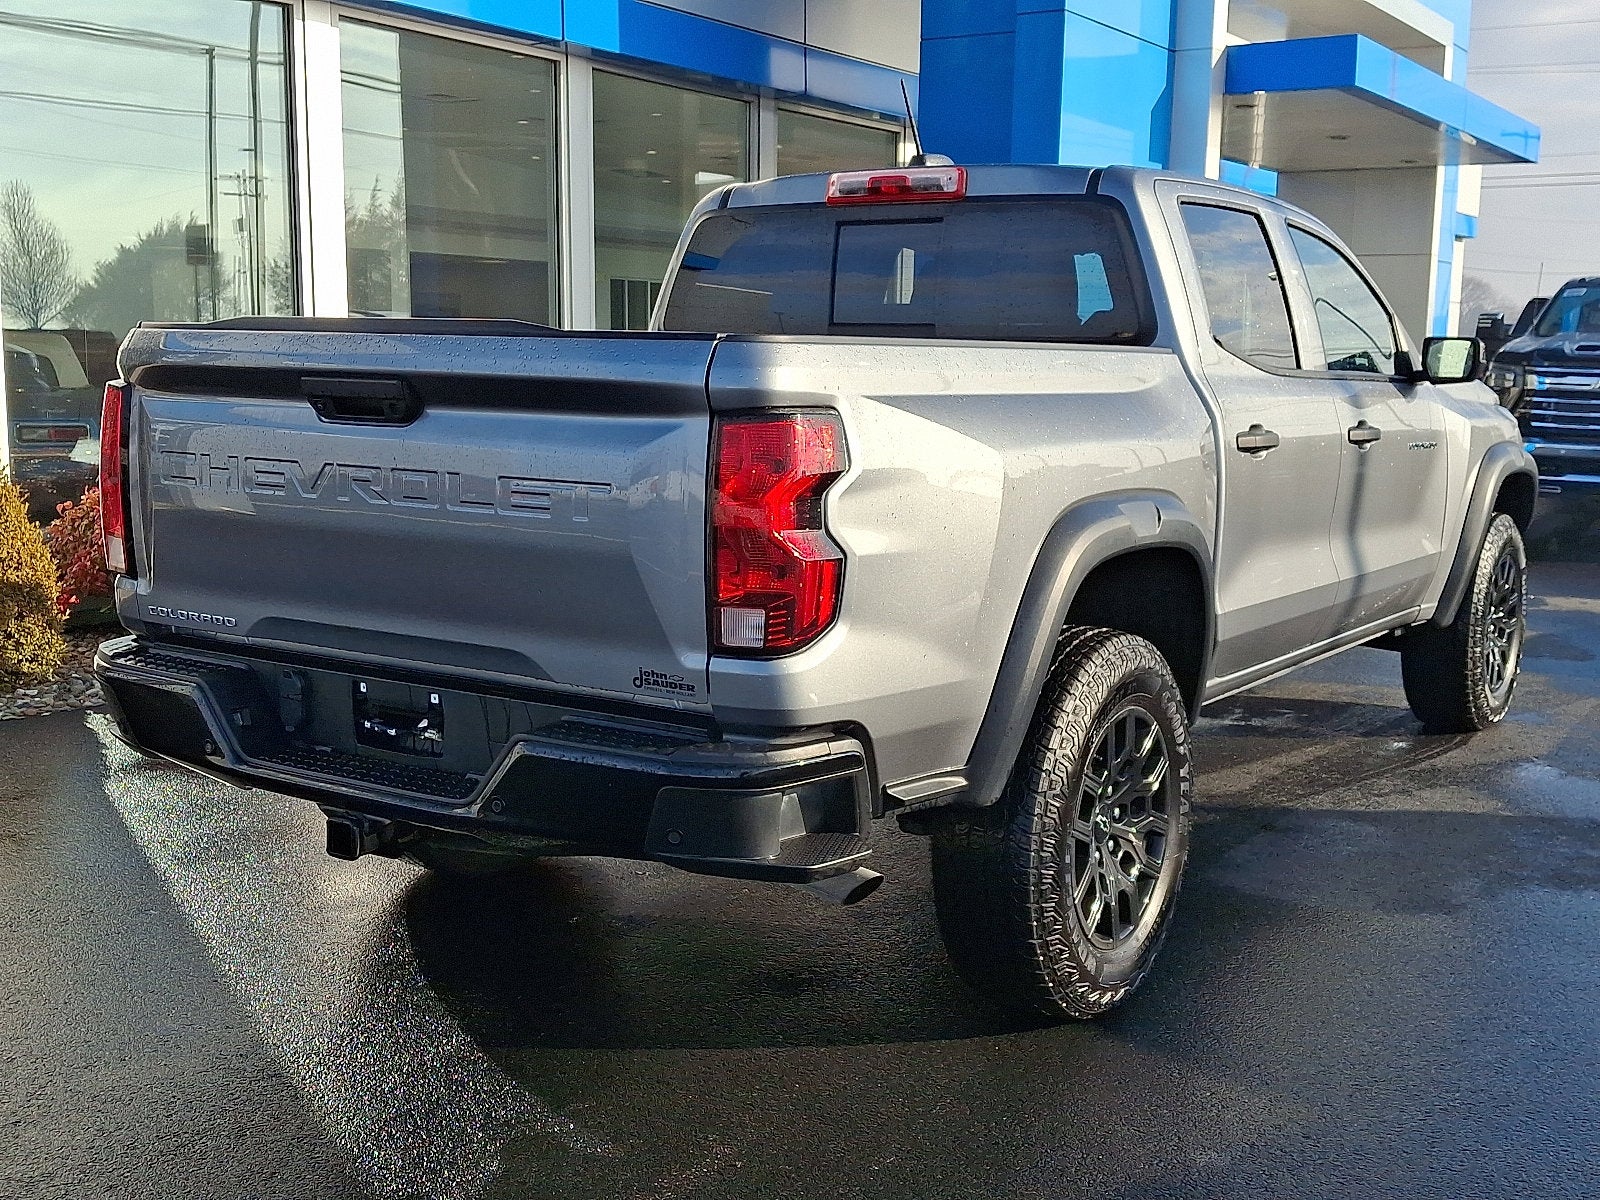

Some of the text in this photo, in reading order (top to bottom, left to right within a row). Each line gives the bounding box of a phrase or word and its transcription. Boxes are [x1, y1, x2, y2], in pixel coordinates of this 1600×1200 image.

[160, 450, 615, 522] CHEVROLET
[147, 605, 236, 627] COLORADO
[643, 678, 696, 693] SAUDER
